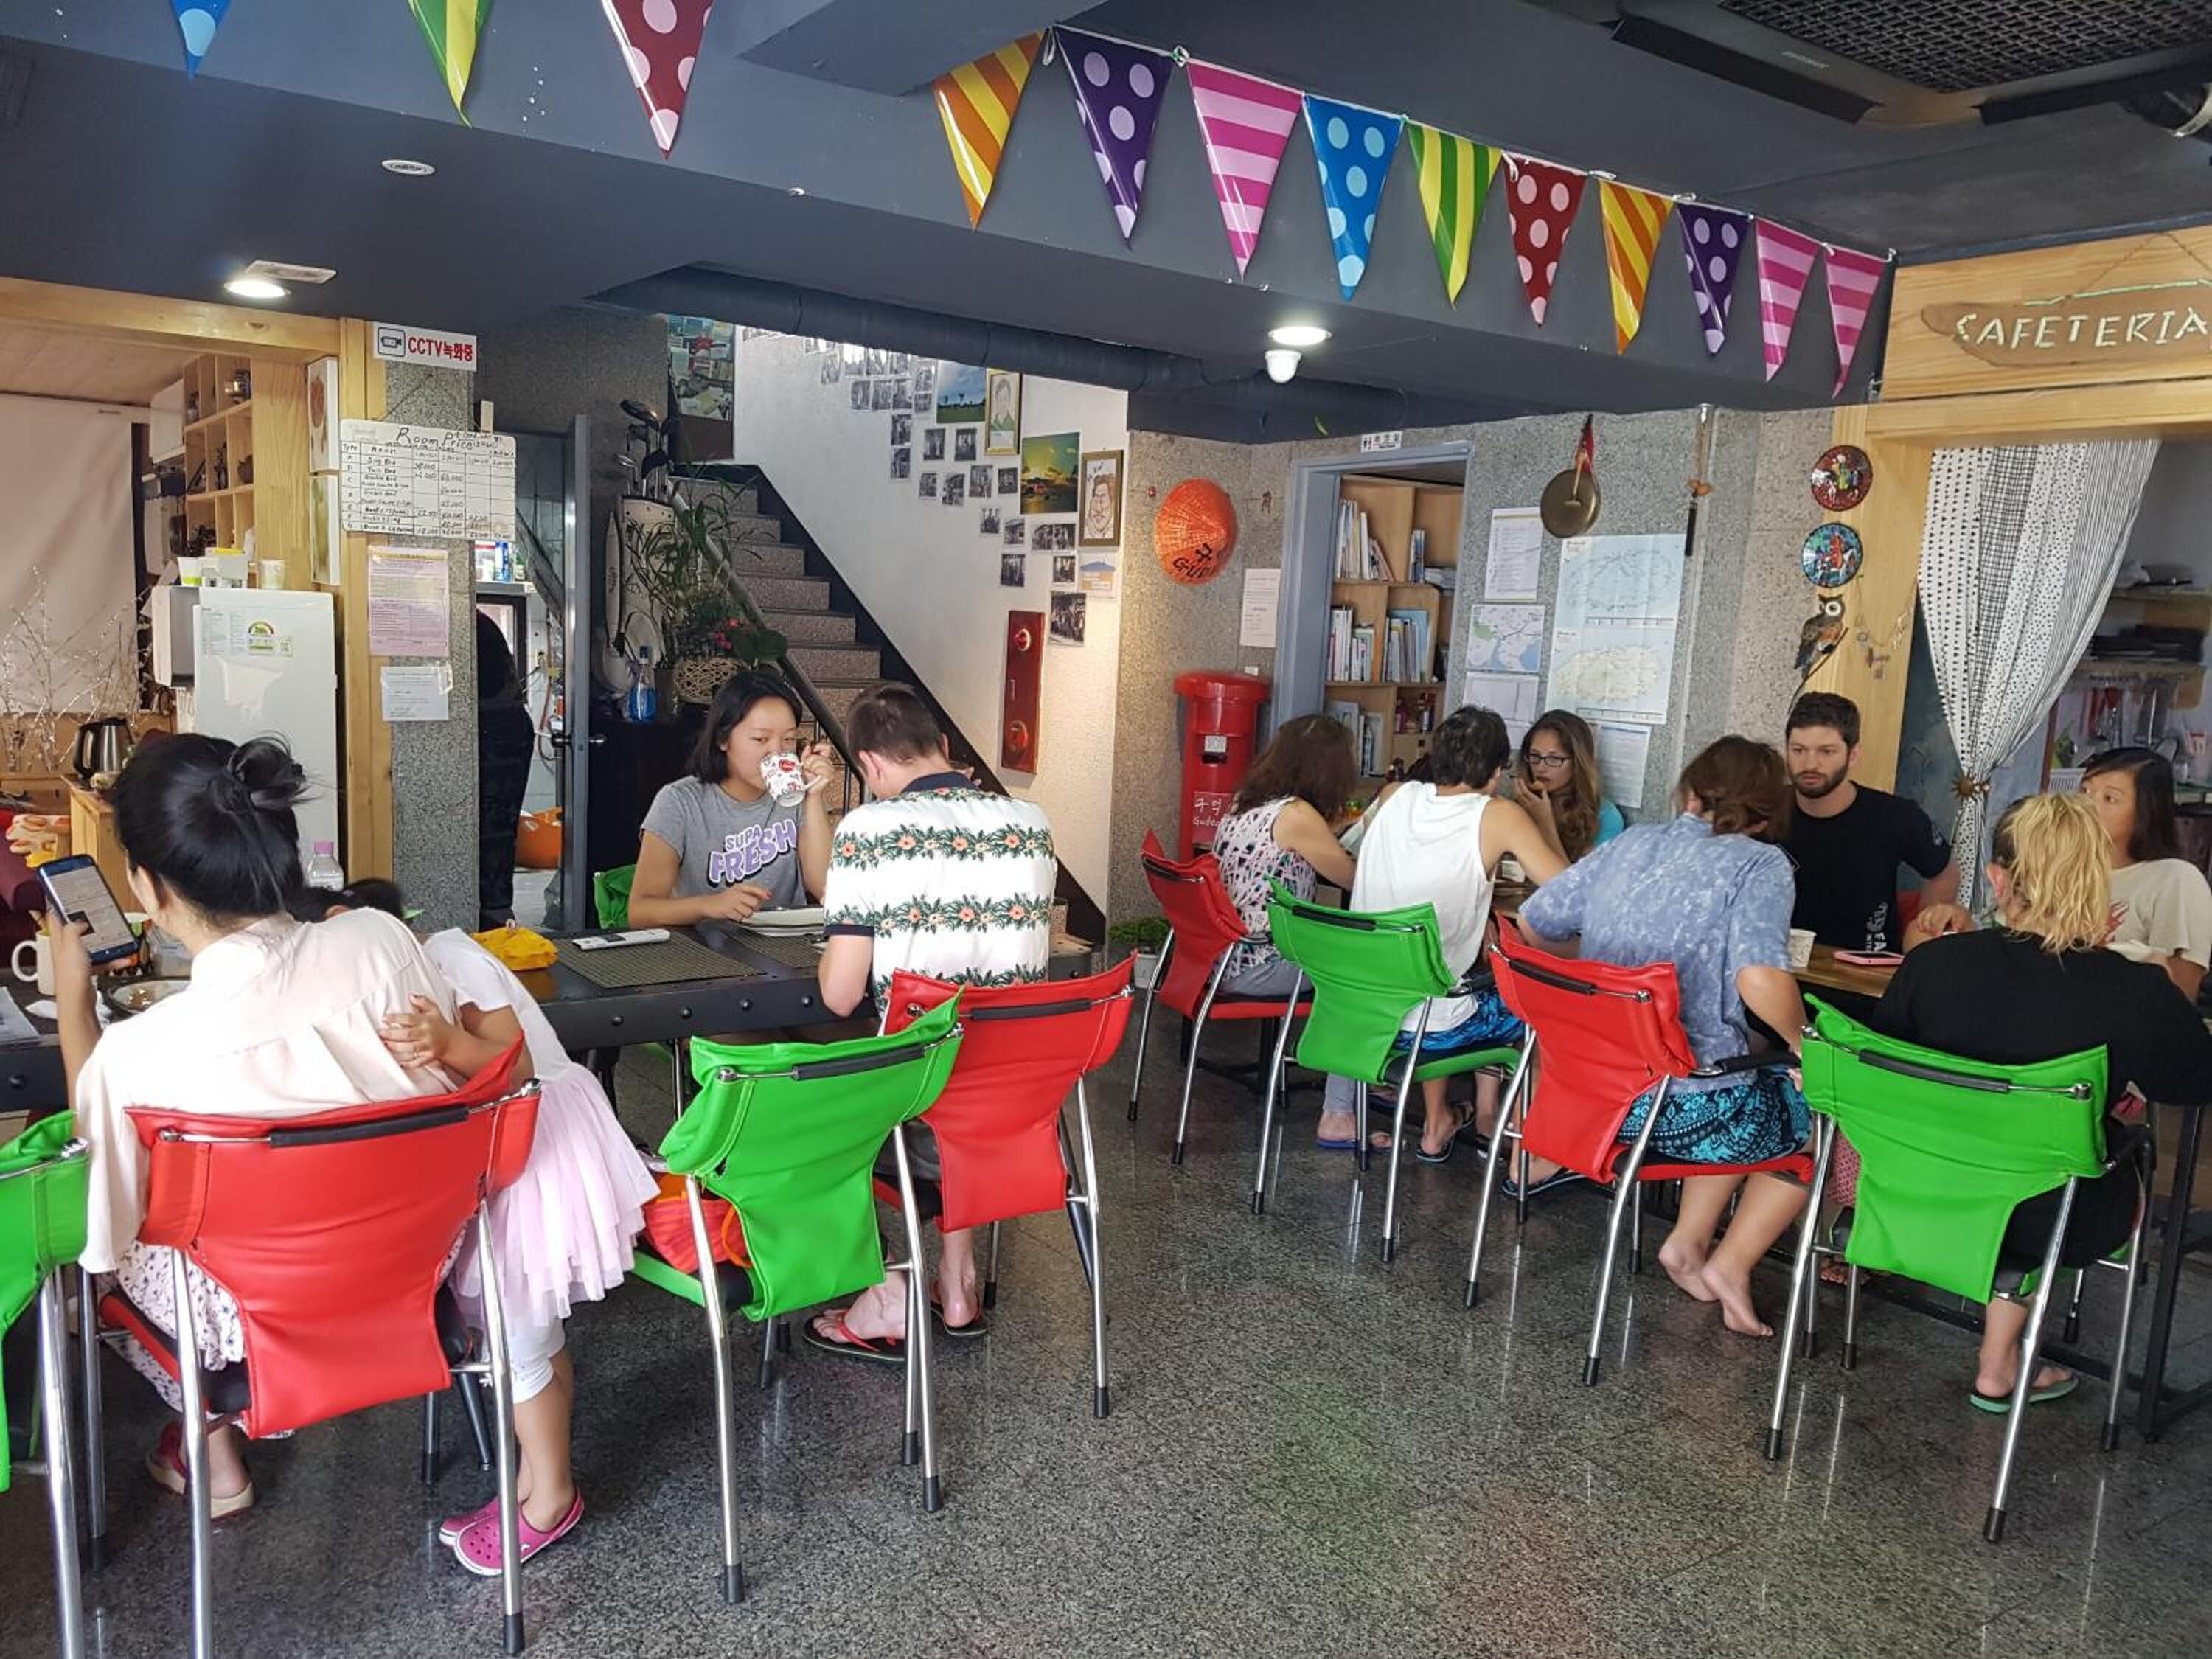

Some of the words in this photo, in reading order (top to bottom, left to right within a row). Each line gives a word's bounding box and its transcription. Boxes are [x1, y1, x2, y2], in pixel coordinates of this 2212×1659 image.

[1956, 306, 2208, 349] CAFETERIA
[408, 337, 473, 362] CCTV녹화중
[396, 427, 439, 446] Room
[709, 819, 797, 885] FRESH
[725, 824, 762, 852] SUPA
